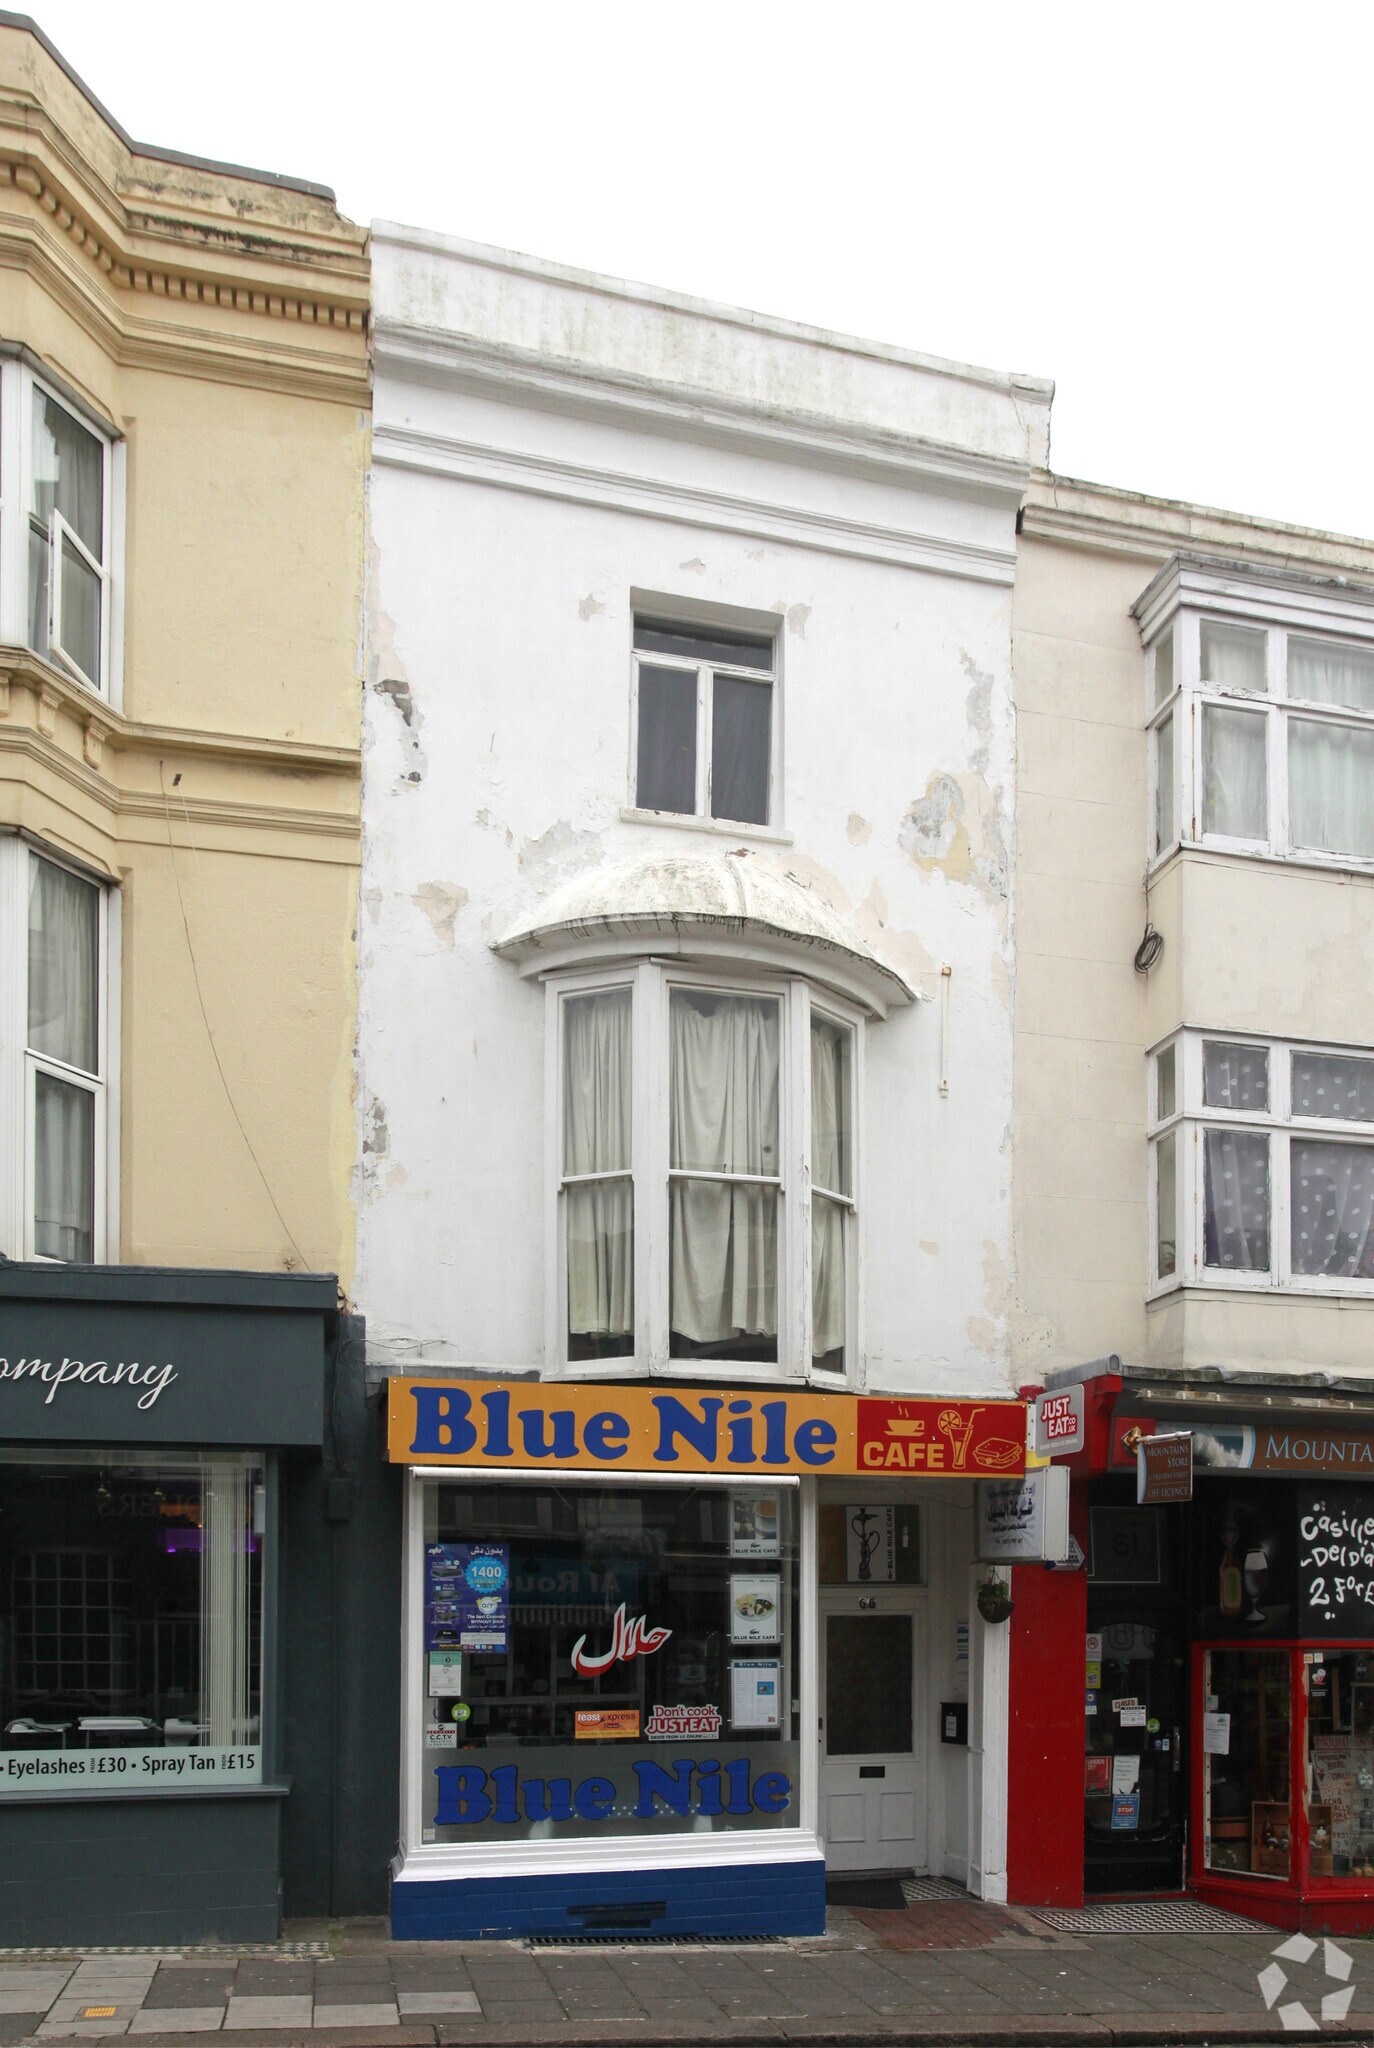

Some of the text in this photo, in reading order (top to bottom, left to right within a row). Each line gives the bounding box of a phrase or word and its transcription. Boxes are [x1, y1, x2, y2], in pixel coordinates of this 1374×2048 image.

[1042, 1396, 1070, 1420] JUST
[409, 1386, 837, 1465] Blue Nile
[1048, 1416, 1069, 1437] EAT
[863, 1441, 944, 1468] CAFE
[1167, 1456, 1189, 1468] STORE
[1148, 1485, 1188, 1497] OFF LICENCE
[471, 1566, 502, 1577] 1400
[1310, 1577, 1330, 1606] 2
[571, 1602, 672, 1677] حلال
[577, 1713, 600, 1721] feast
[655, 1705, 716, 1716] Don't cook
[648, 1717, 719, 1733] JUST EAT
[8, 1757, 85, 1779] Eyelashes
[97, 1757, 127, 1773] £30
[142, 1755, 186, 1775] Spray
[189, 1754, 216, 1770] Tan
[227, 1754, 255, 1769] £15
[433, 1758, 792, 1825] Blue Nile
